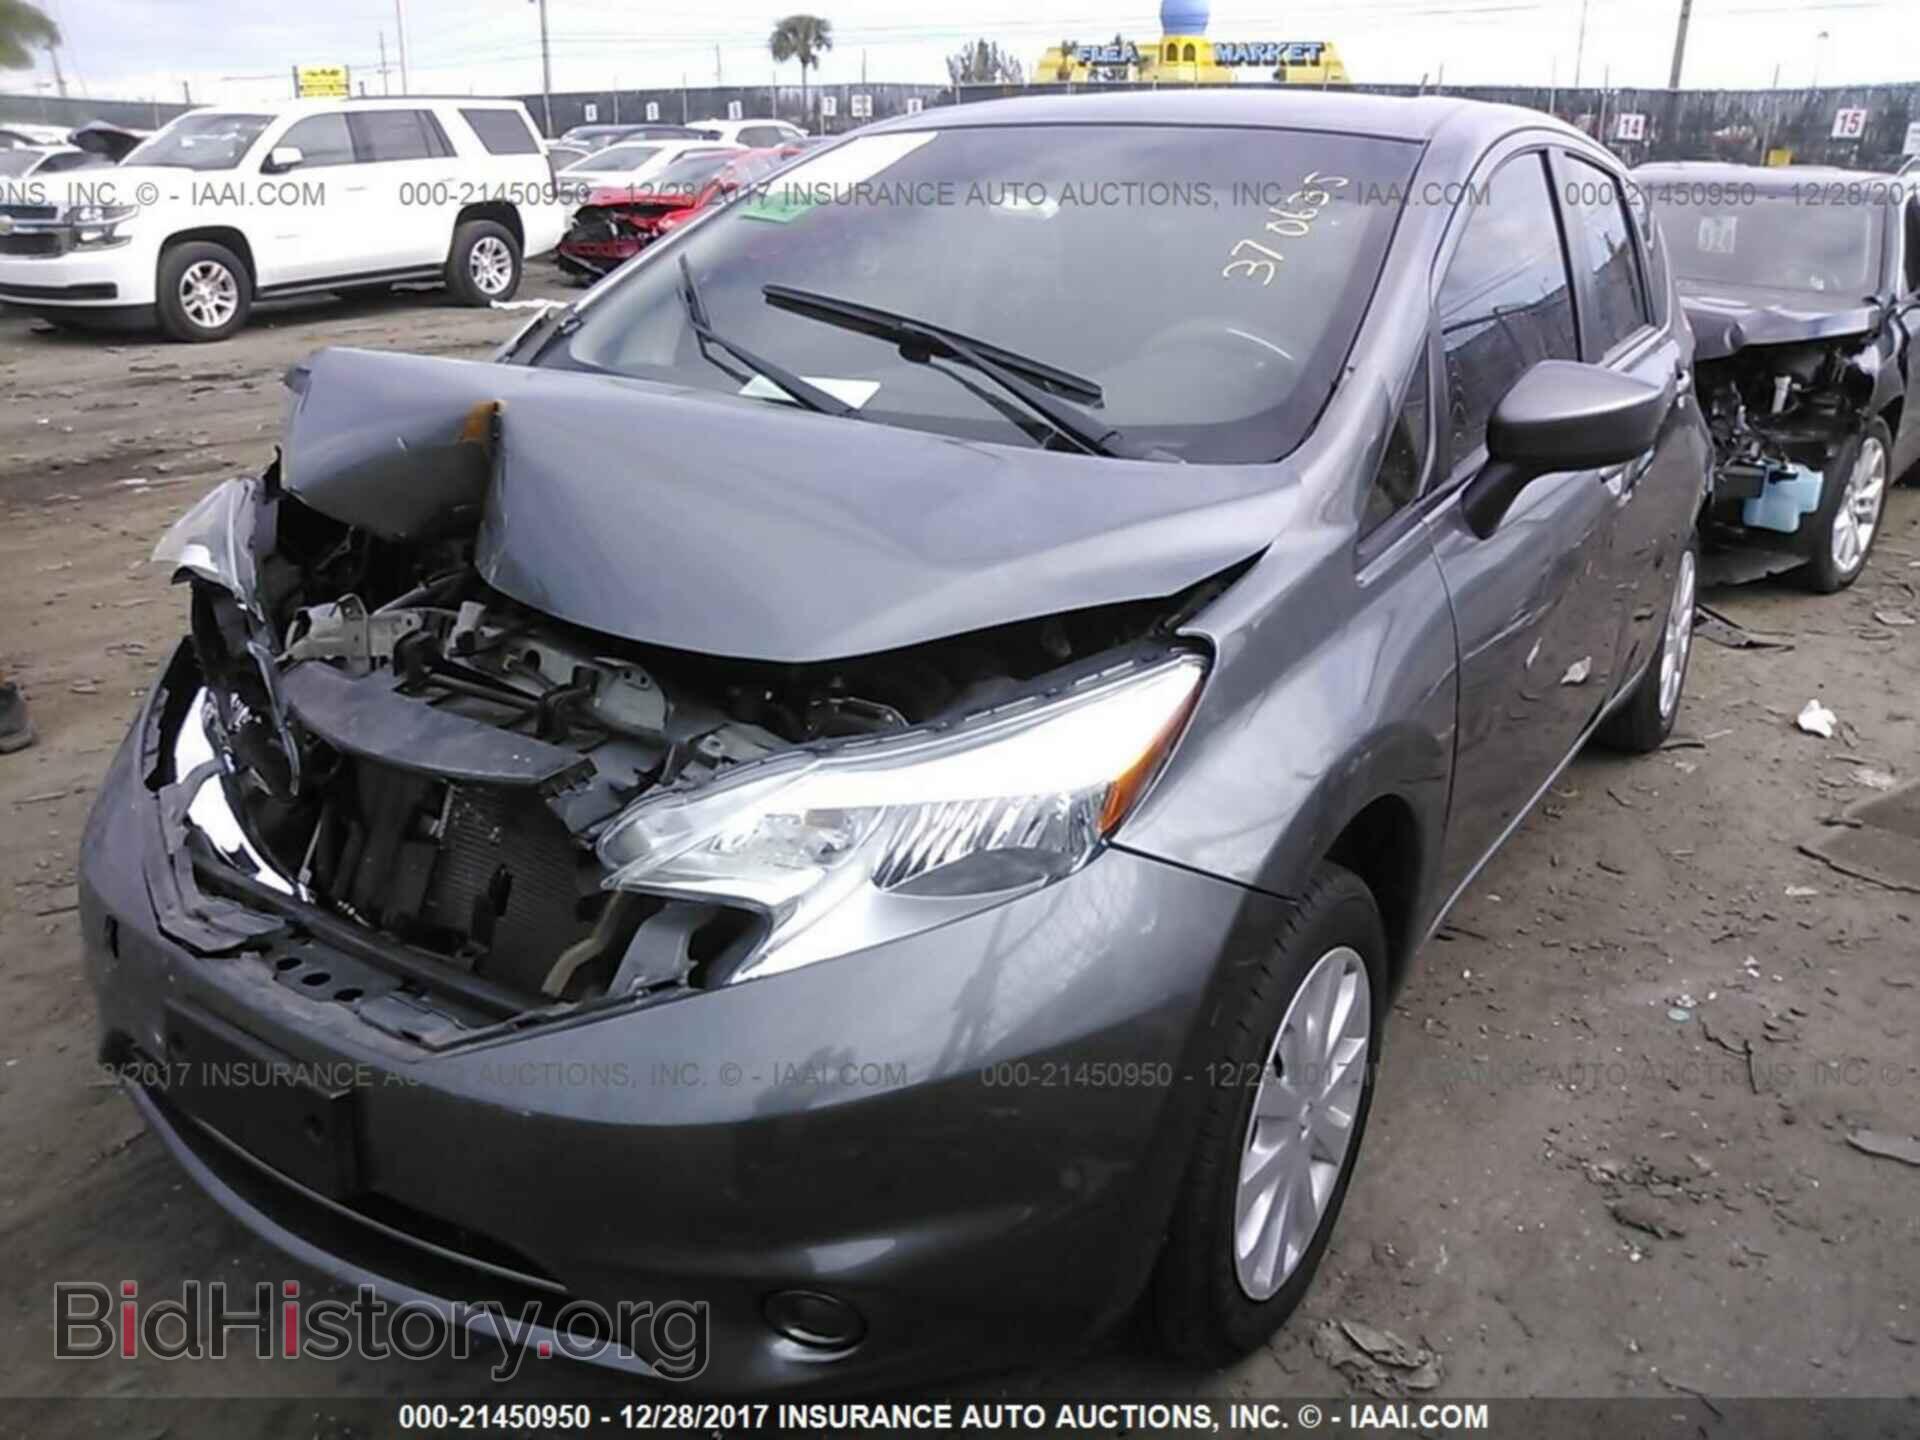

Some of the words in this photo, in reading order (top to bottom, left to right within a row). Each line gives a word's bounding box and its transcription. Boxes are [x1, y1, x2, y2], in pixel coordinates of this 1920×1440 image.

[1074, 42, 1140, 66] FLEA
[1214, 41, 1326, 67] MARKET
[1623, 117, 1640, 136] 14
[1840, 112, 1861, 134] 15
[1222, 239, 1284, 286] 37
